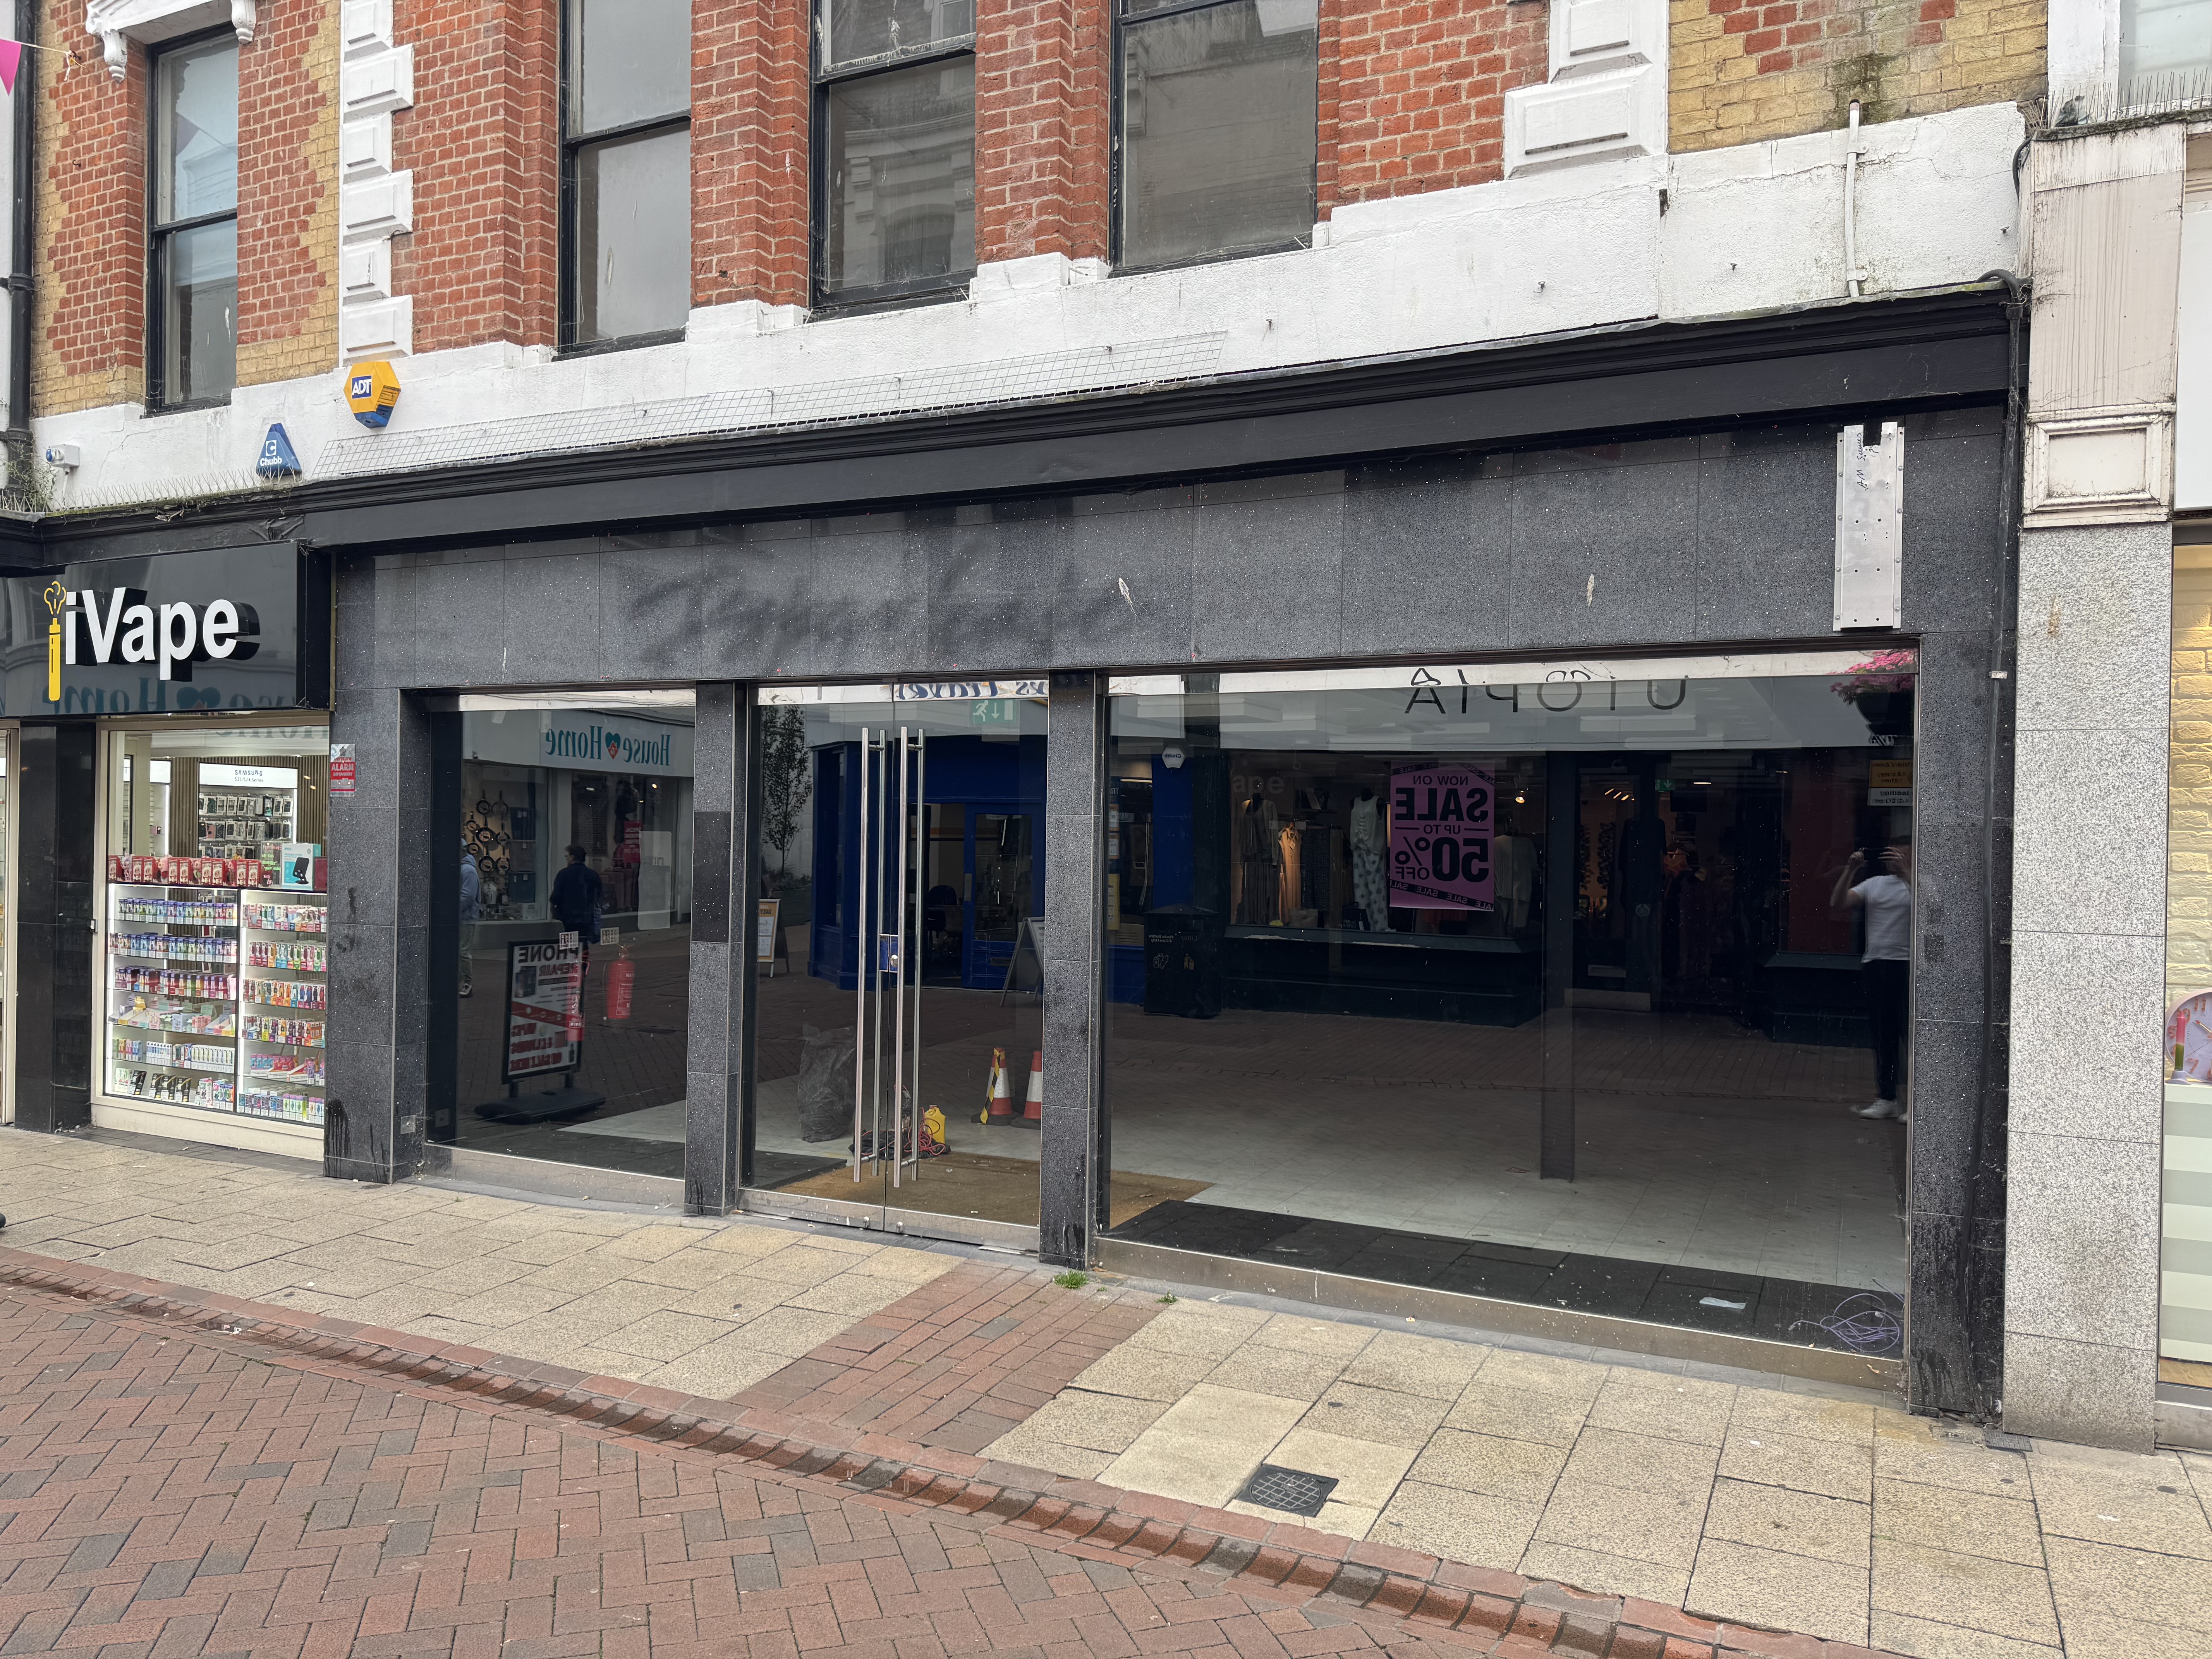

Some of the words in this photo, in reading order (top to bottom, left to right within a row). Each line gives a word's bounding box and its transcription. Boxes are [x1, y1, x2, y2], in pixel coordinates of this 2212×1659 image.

[352, 379, 371, 396] ADT
[260, 456, 282, 467] Chubb
[65, 587, 239, 680] iVape
[331, 763, 354, 771] ALARM
[2194, 997, 2206, 1012] 11
[2187, 1058, 2199, 1073] 7
